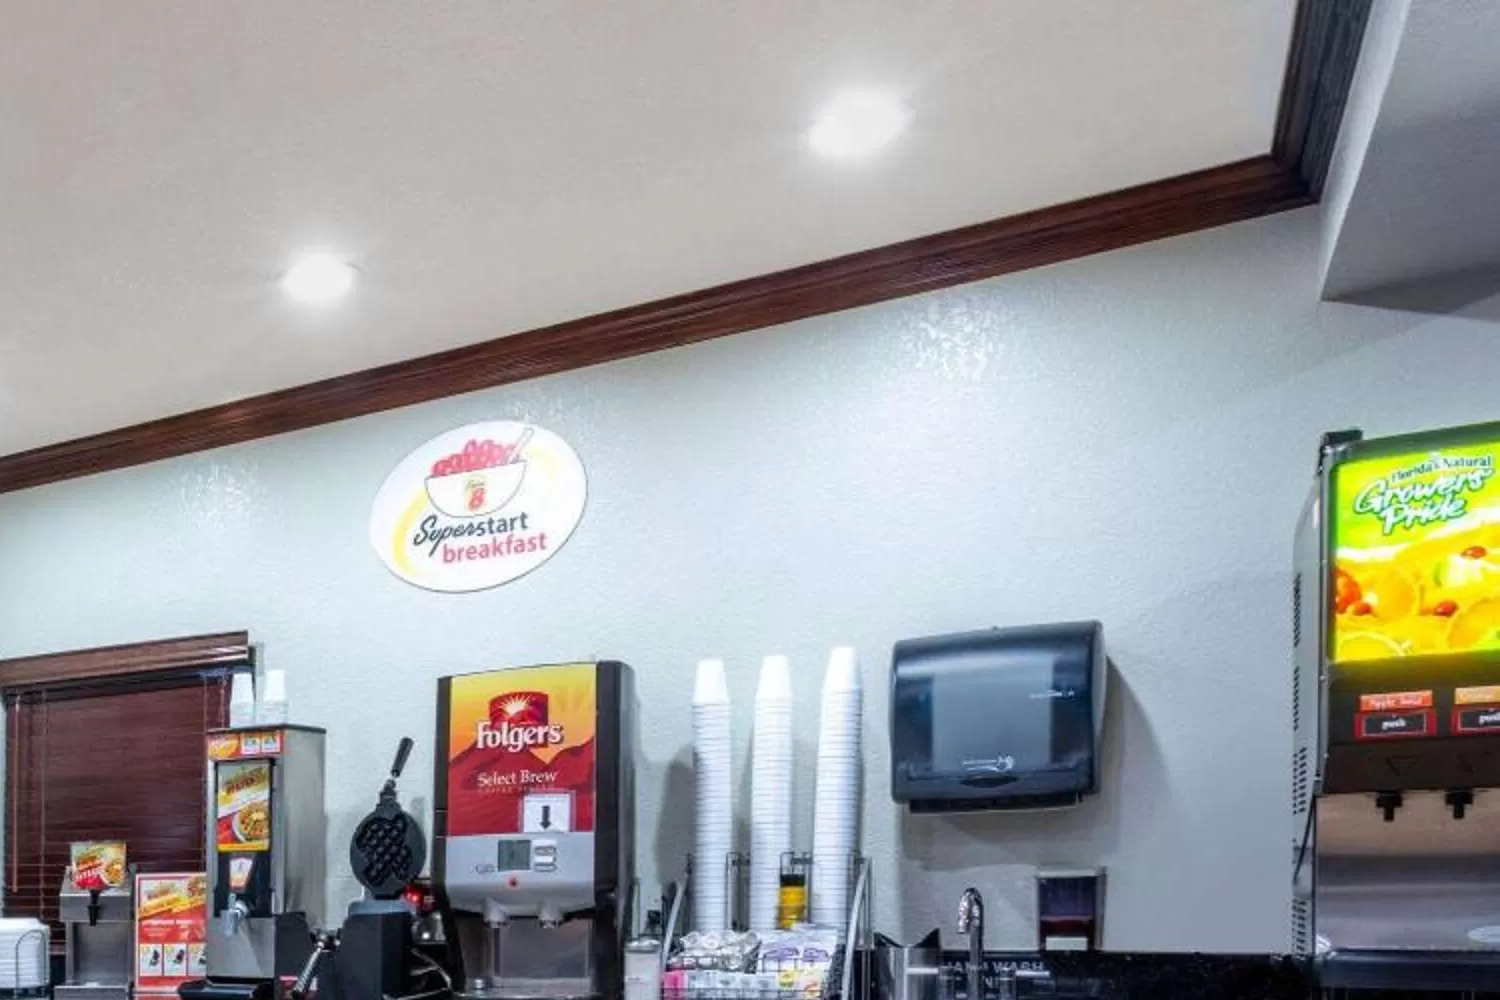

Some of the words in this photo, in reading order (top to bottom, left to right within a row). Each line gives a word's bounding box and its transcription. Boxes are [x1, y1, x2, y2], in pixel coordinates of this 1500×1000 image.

[1377, 497, 1467, 536] Pride
[413, 511, 529, 558] Superstart
[442, 531, 548, 564] breakfast
[476, 720, 564, 753] Folgers
[477, 771, 516, 787] Select
[520, 769, 559, 784] Brew
